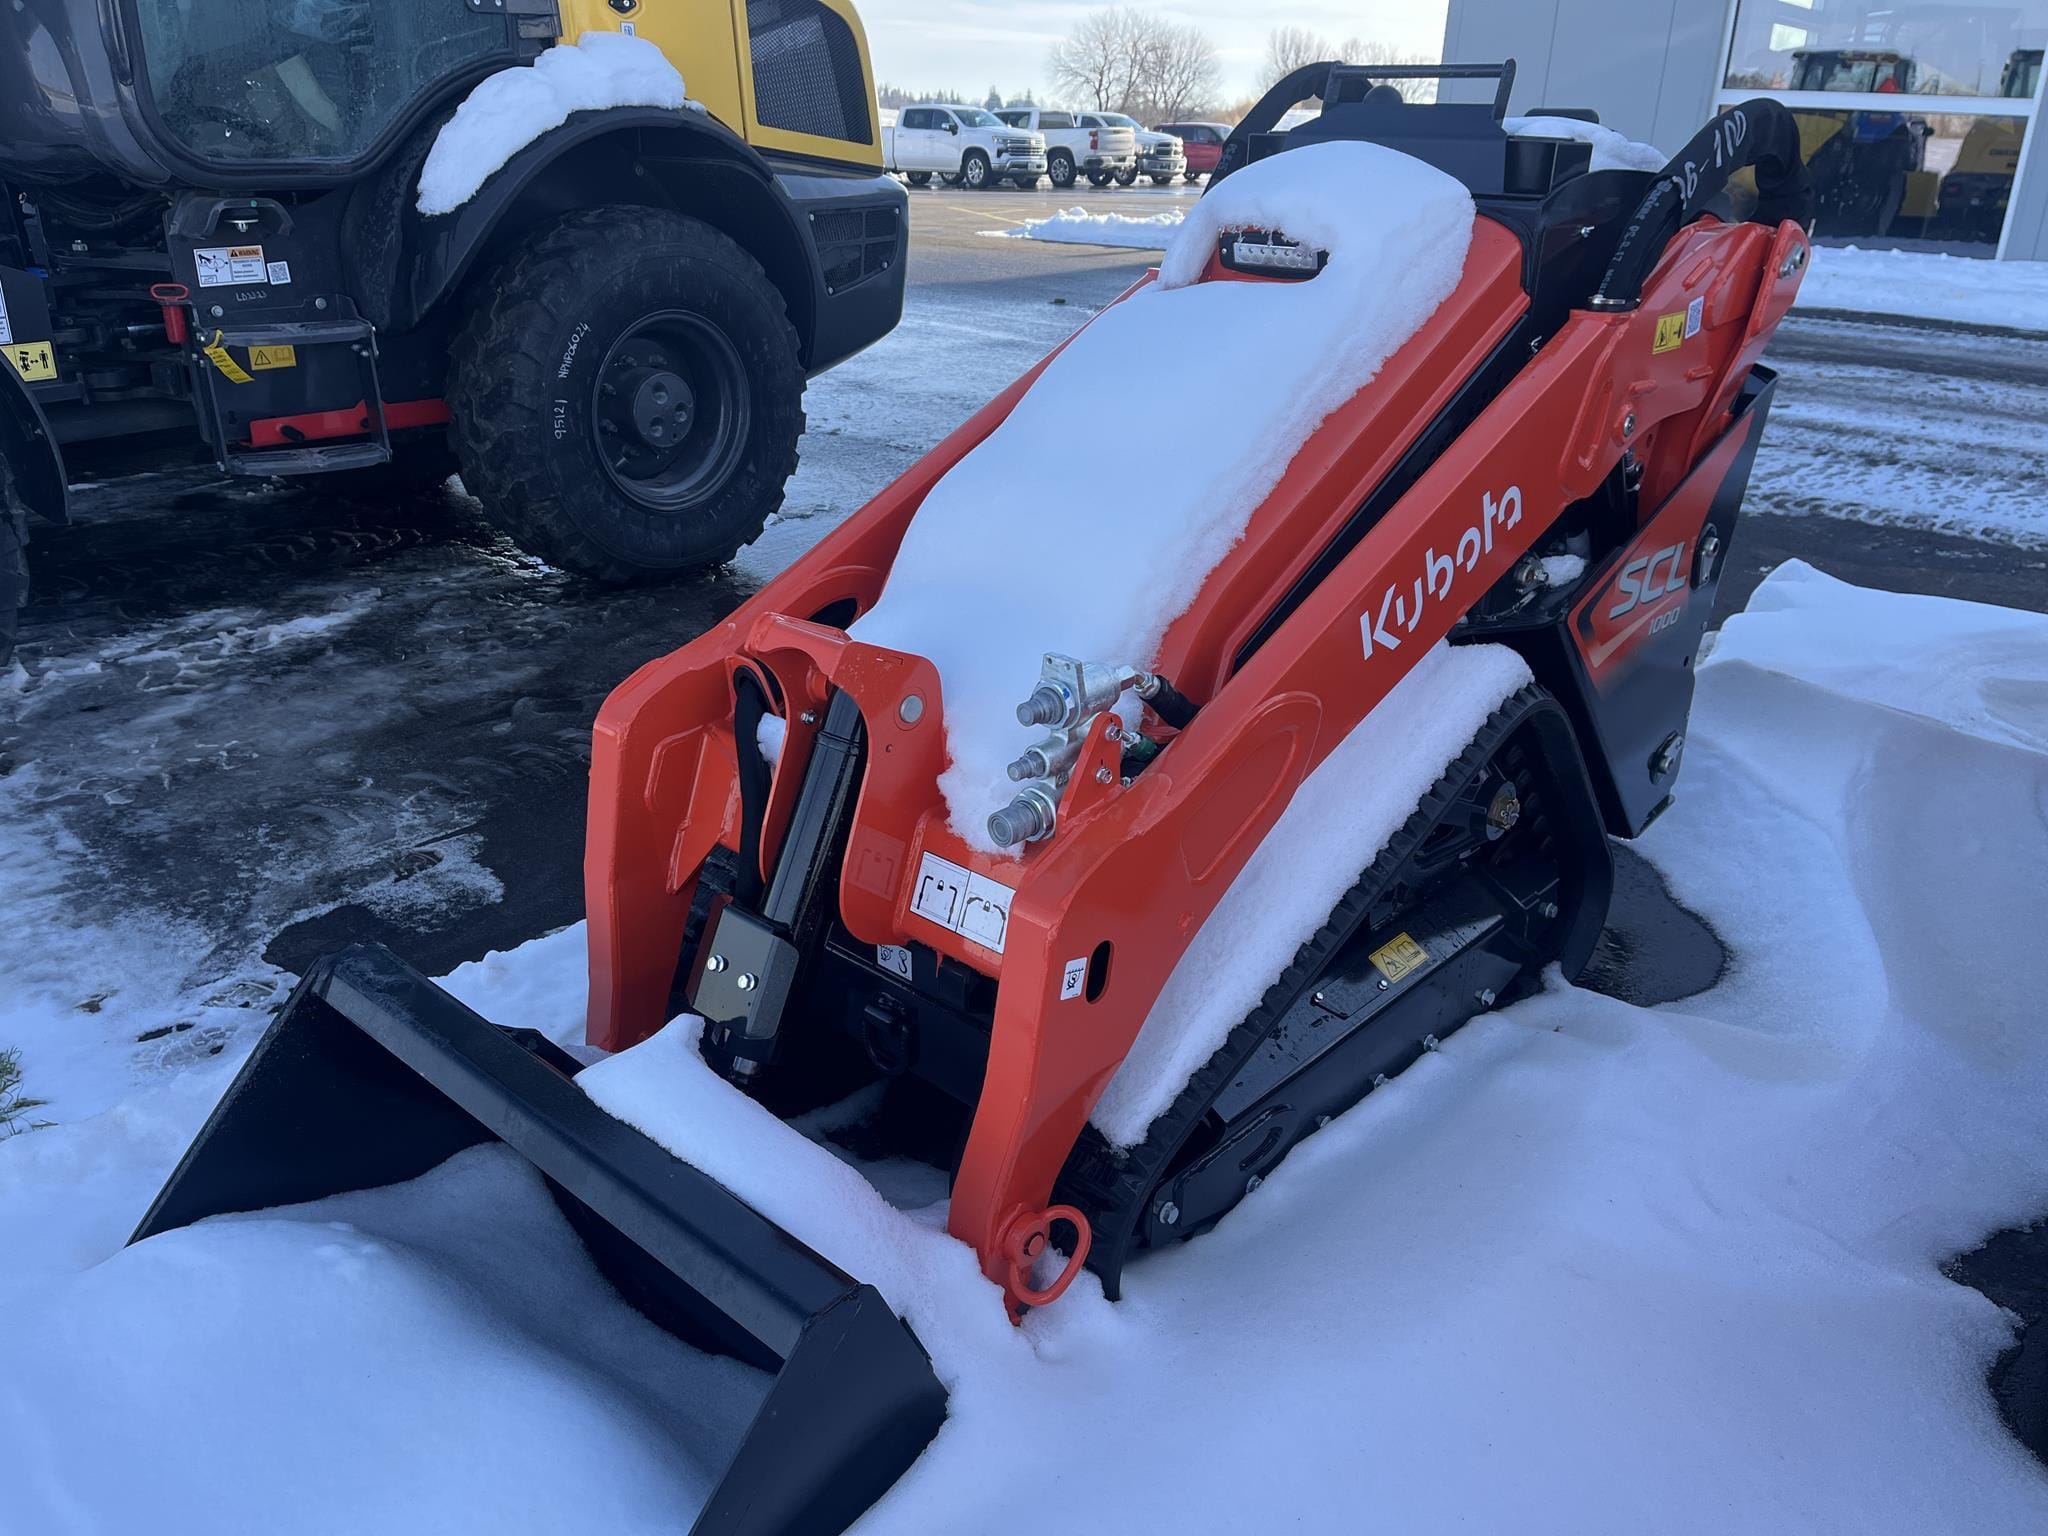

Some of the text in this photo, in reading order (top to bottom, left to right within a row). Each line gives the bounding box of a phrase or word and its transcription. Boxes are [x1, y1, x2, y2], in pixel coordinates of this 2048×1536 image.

[554, 399, 568, 440] 95121
[1359, 485, 1522, 661] Kubota
[1608, 541, 1687, 620] SCL
[1648, 606, 1681, 636] 1000
